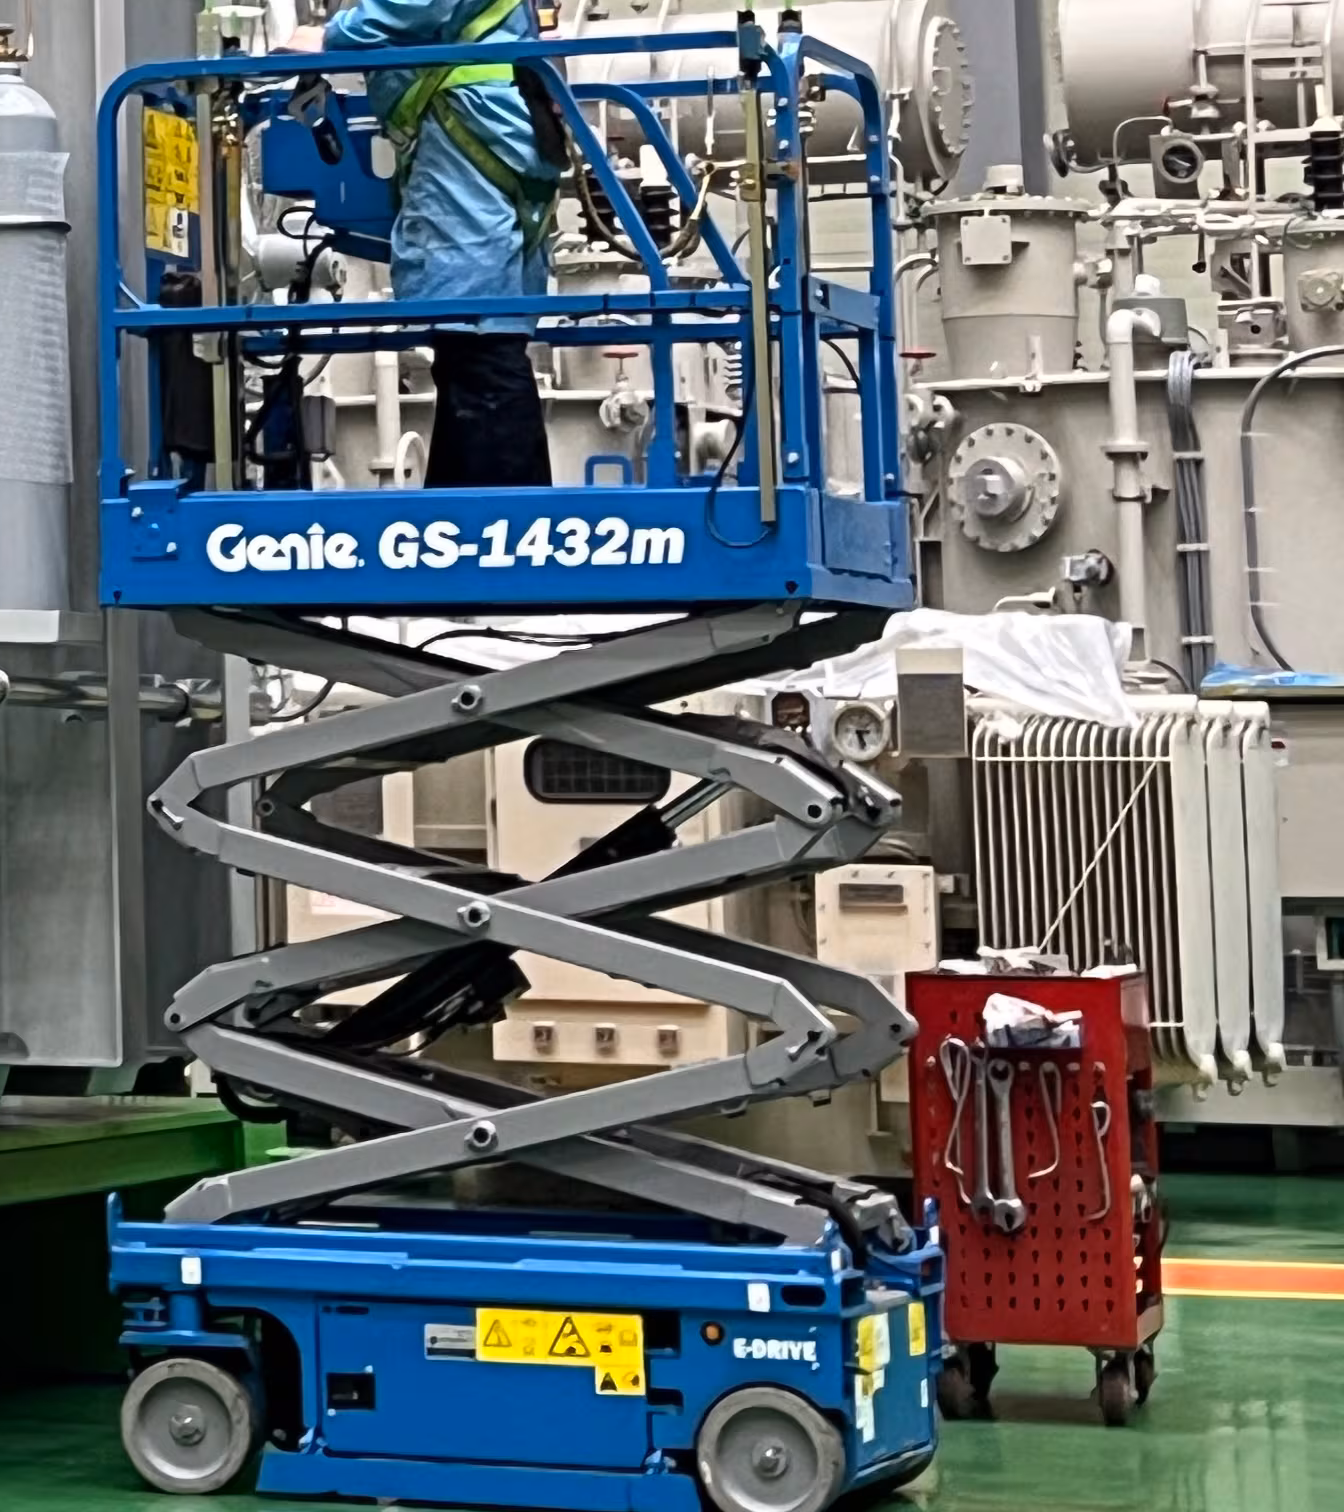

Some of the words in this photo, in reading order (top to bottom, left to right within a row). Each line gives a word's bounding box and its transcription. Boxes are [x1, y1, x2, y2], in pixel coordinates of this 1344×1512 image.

[206, 522, 359, 573] Genie
[378, 516, 686, 570] GS-1432m
[733, 1337, 817, 1362] E-DRIVE
